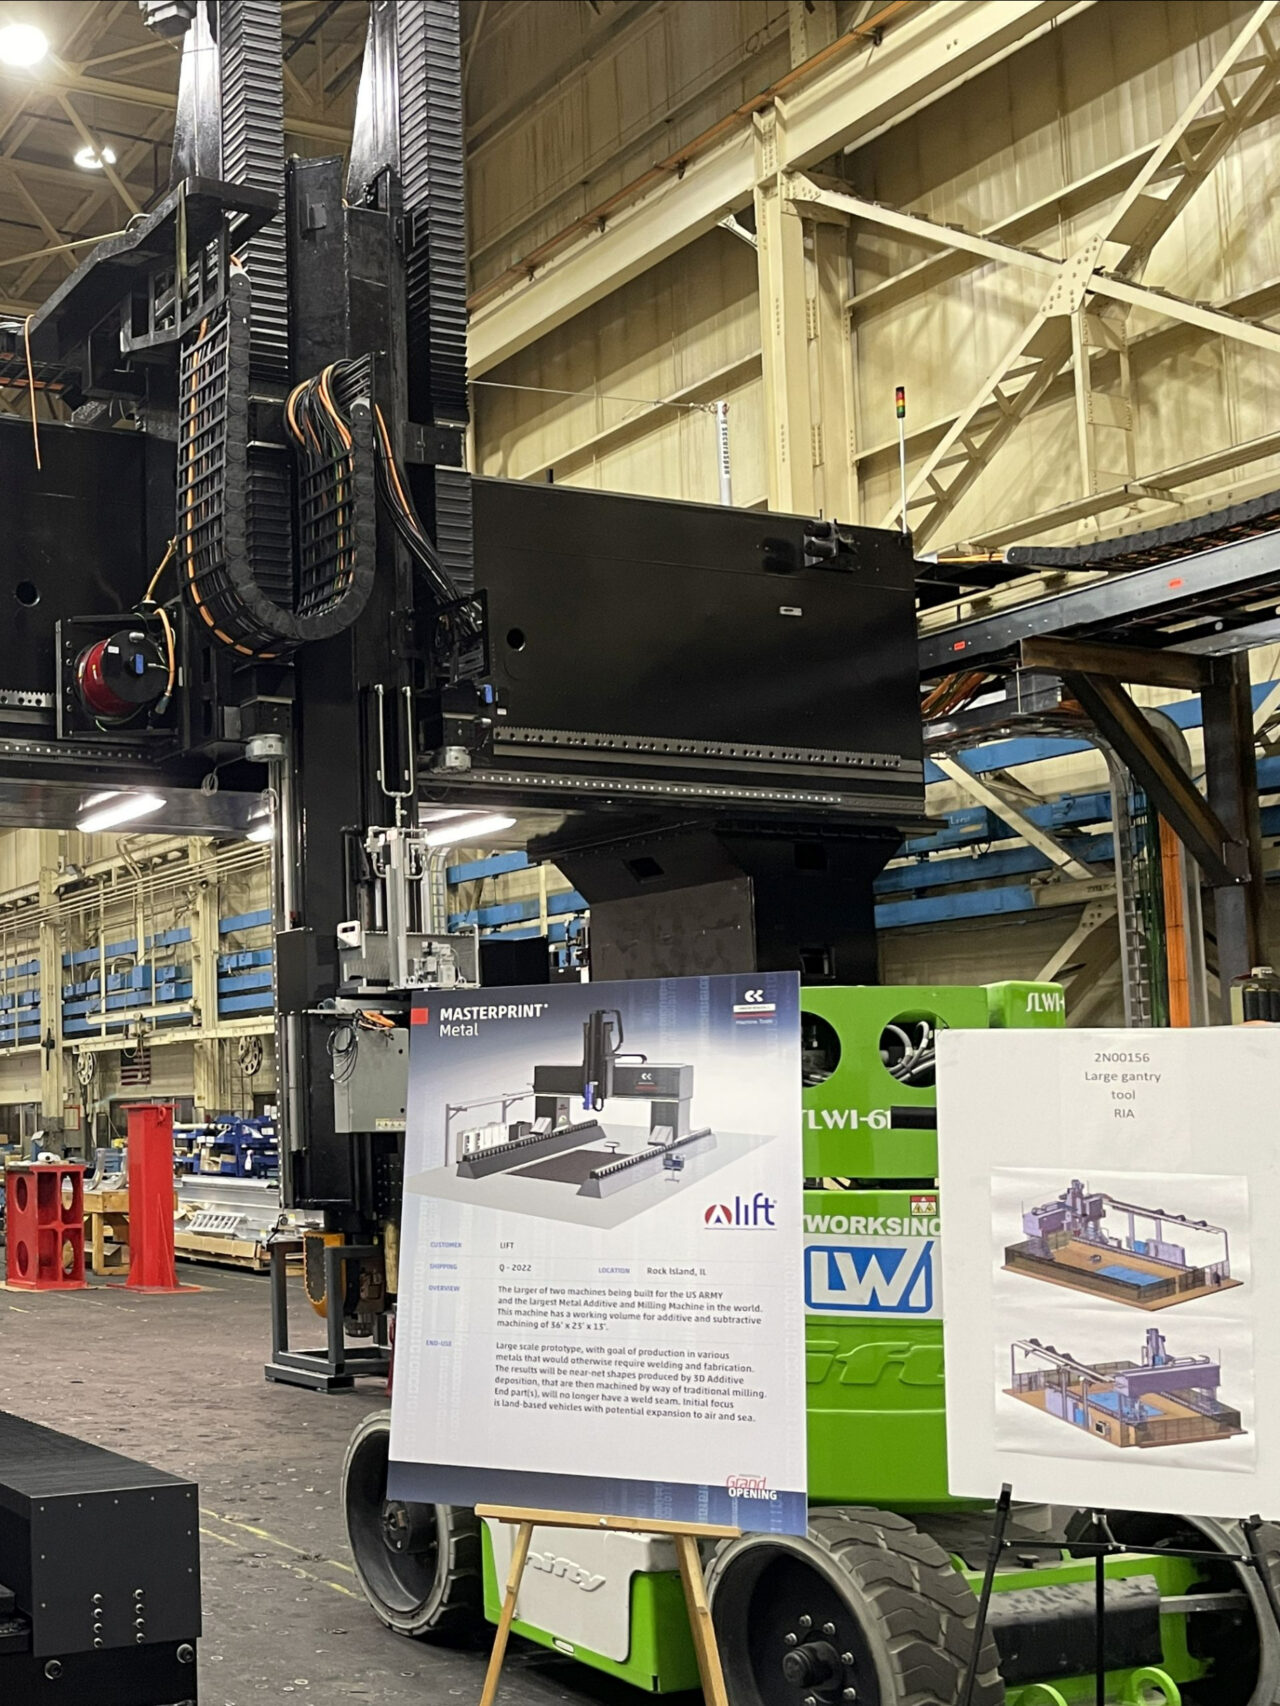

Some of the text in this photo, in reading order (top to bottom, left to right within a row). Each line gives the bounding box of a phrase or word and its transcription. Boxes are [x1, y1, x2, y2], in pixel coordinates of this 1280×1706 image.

[440, 1023, 478, 1037] Metal
[1094, 1052, 1150, 1062] 2N00156
[1084, 1072, 1162, 1083] Large gantry
[1111, 1090, 1136, 1100] tool
[1114, 1108, 1135, 1118] RIA
[735, 1192, 775, 1226] lift
[512, 1264, 532, 1272] 2022
[647, 1267, 706, 1276] Rock Island, IL
[498, 1286, 723, 1299] The larger of two machines being built for the US ARMY
[498, 1297, 763, 1312] and the largest Metal Additive and Milling Machine in the world.
[498, 1309, 513, 1317] This
[514, 1309, 549, 1318] machine
[550, 1310, 564, 1319] has
[573, 1311, 608, 1321] working
[609, 1312, 641, 1321] volume
[643, 1313, 655, 1321] for
[657, 1313, 692, 1322] additive
[694, 1314, 711, 1323] and
[713, 1315, 762, 1324] subtractive
[497, 1320, 539, 1330] machining
[540, 1321, 549, 1330] of
[496, 1342, 730, 1359] Large scale prototype, with goal of production in various
[496, 1353, 754, 1372] metals that would otherwise require welding and fabrication.
[496, 1365, 509, 1373] The
[511, 1366, 538, 1375] results
[539, 1367, 556, 1375] will
[557, 1367, 568, 1376] be
[569, 1368, 605, 1378] near-net
[607, 1370, 636, 1380] shapes
[638, 1371, 679, 1382] produced
[681, 1373, 692, 1383] by
[707, 1374, 744, 1384] Additive
[495, 1376, 540, 1387] deposition,
[541, 1378, 559, 1387] that
[575, 1380, 595, 1389] then
[596, 1381, 638, 1391] machined
[639, 1383, 651, 1393] by
[652, 1386, 671, 1394] way
[672, 1385, 682, 1394] of
[683, 1385, 730, 1396] traditional
[732, 1388, 767, 1399] milling.
[494, 1388, 509, 1397] End
[541, 1390, 558, 1399] will
[572, 1392, 600, 1402] longer
[601, 1393, 622, 1402] have
[631, 1395, 653, 1404] weld
[683, 1397, 709, 1407] Initial
[710, 1399, 734, 1408] focus
[494, 1399, 500, 1408] is
[501, 1400, 547, 1410] land-based
[549, 1402, 582, 1412] vehicles
[584, 1404, 604, 1413] with
[605, 1405, 644, 1417] potential
[646, 1408, 691, 1419] expansion
[693, 1410, 703, 1419] to
[704, 1411, 716, 1420] air
[718, 1412, 736, 1421] and
[726, 1474, 766, 1489] Grand
[728, 1488, 778, 1500] OPENING
